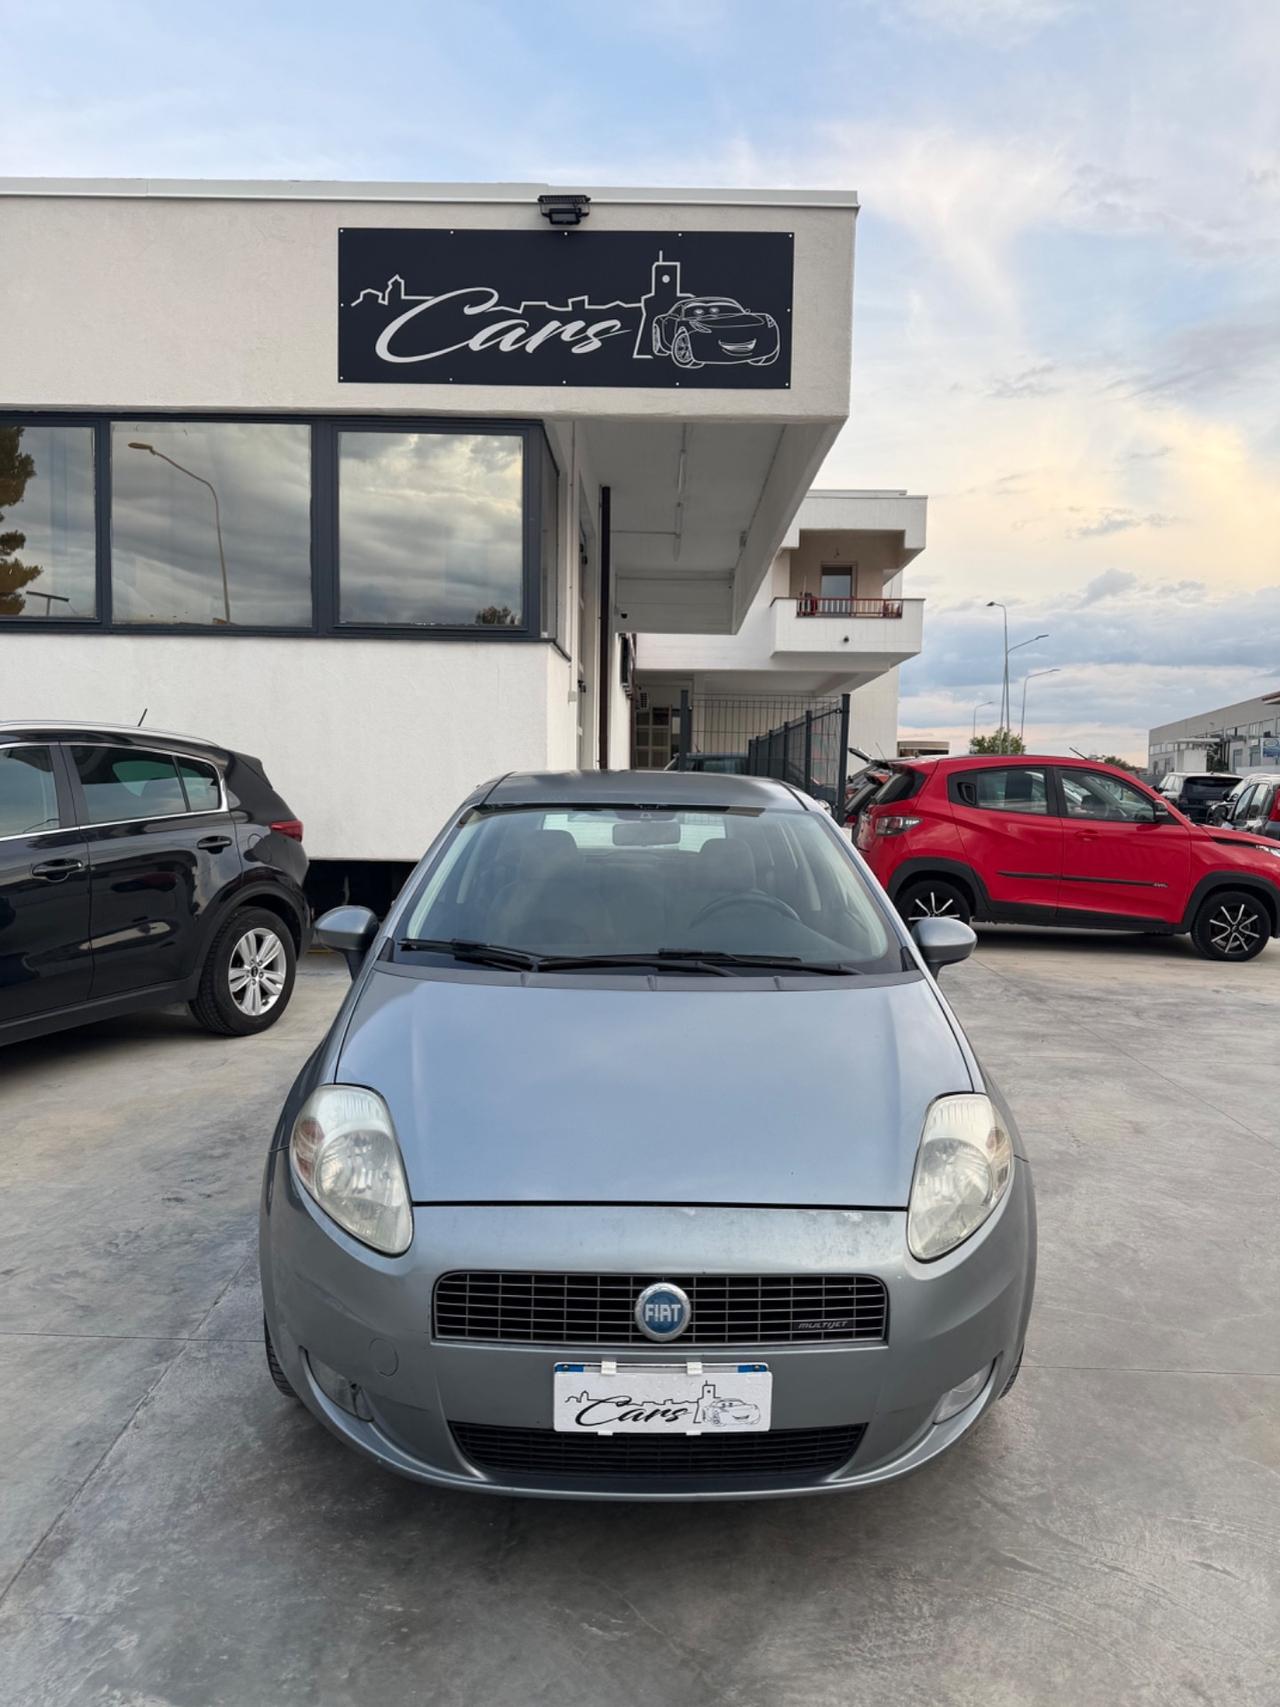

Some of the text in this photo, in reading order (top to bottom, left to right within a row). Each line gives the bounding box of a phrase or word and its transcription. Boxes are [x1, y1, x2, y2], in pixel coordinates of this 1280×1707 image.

[375, 287, 631, 363] Cars
[645, 1304, 681, 1322] FIAT
[575, 1395, 691, 1426] Cars
